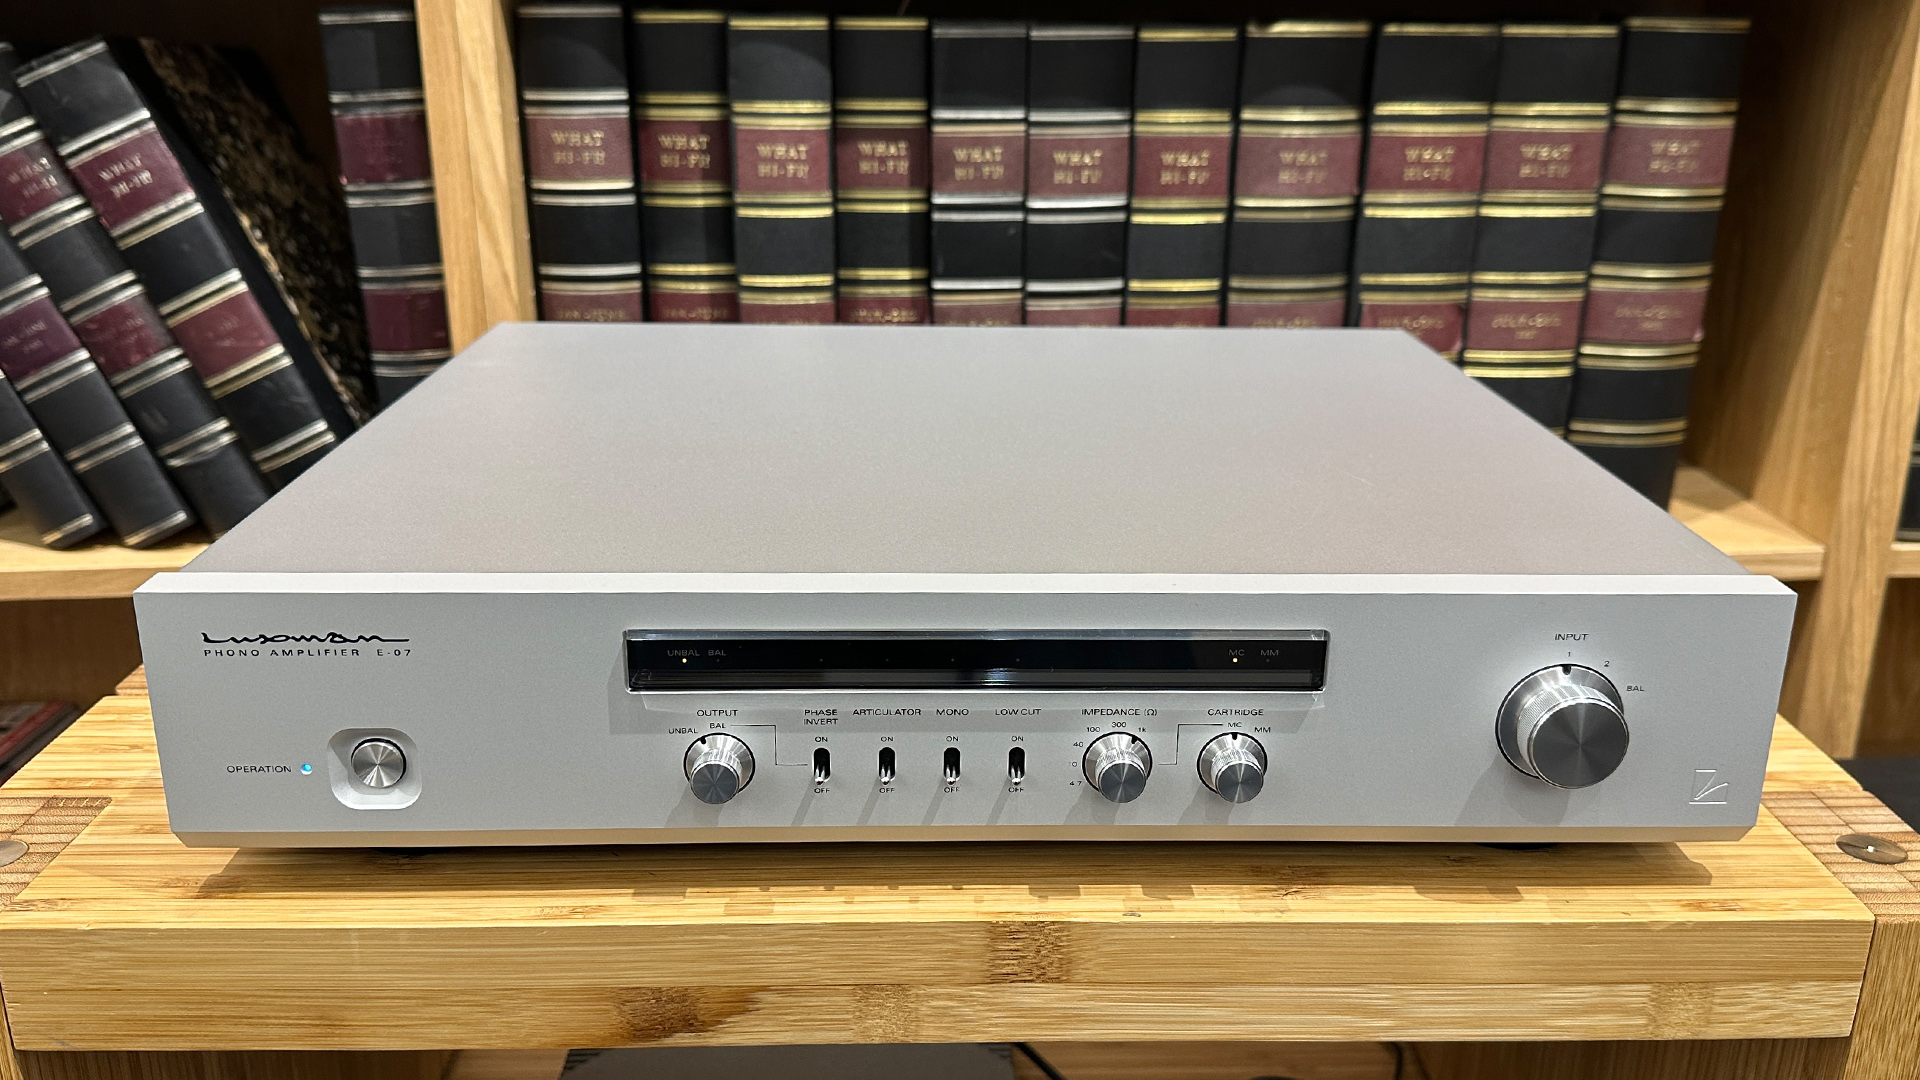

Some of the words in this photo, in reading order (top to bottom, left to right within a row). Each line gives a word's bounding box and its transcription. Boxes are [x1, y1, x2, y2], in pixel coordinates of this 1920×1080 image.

[551, 130, 604, 146] WHAT
[658, 133, 710, 150] WHAT
[756, 142, 809, 160] WHAT
[858, 140, 909, 156] WHAT
[953, 146, 1004, 162] WHAT
[1053, 148, 1102, 166] WHAT
[270, 648, 360, 657] AMPLIFIER
[376, 648, 411, 657] E-07
[804, 708, 838, 717] PHASE
[1207, 708, 1264, 717] CARTRIDGE
[226, 765, 292, 774] OPERATION
